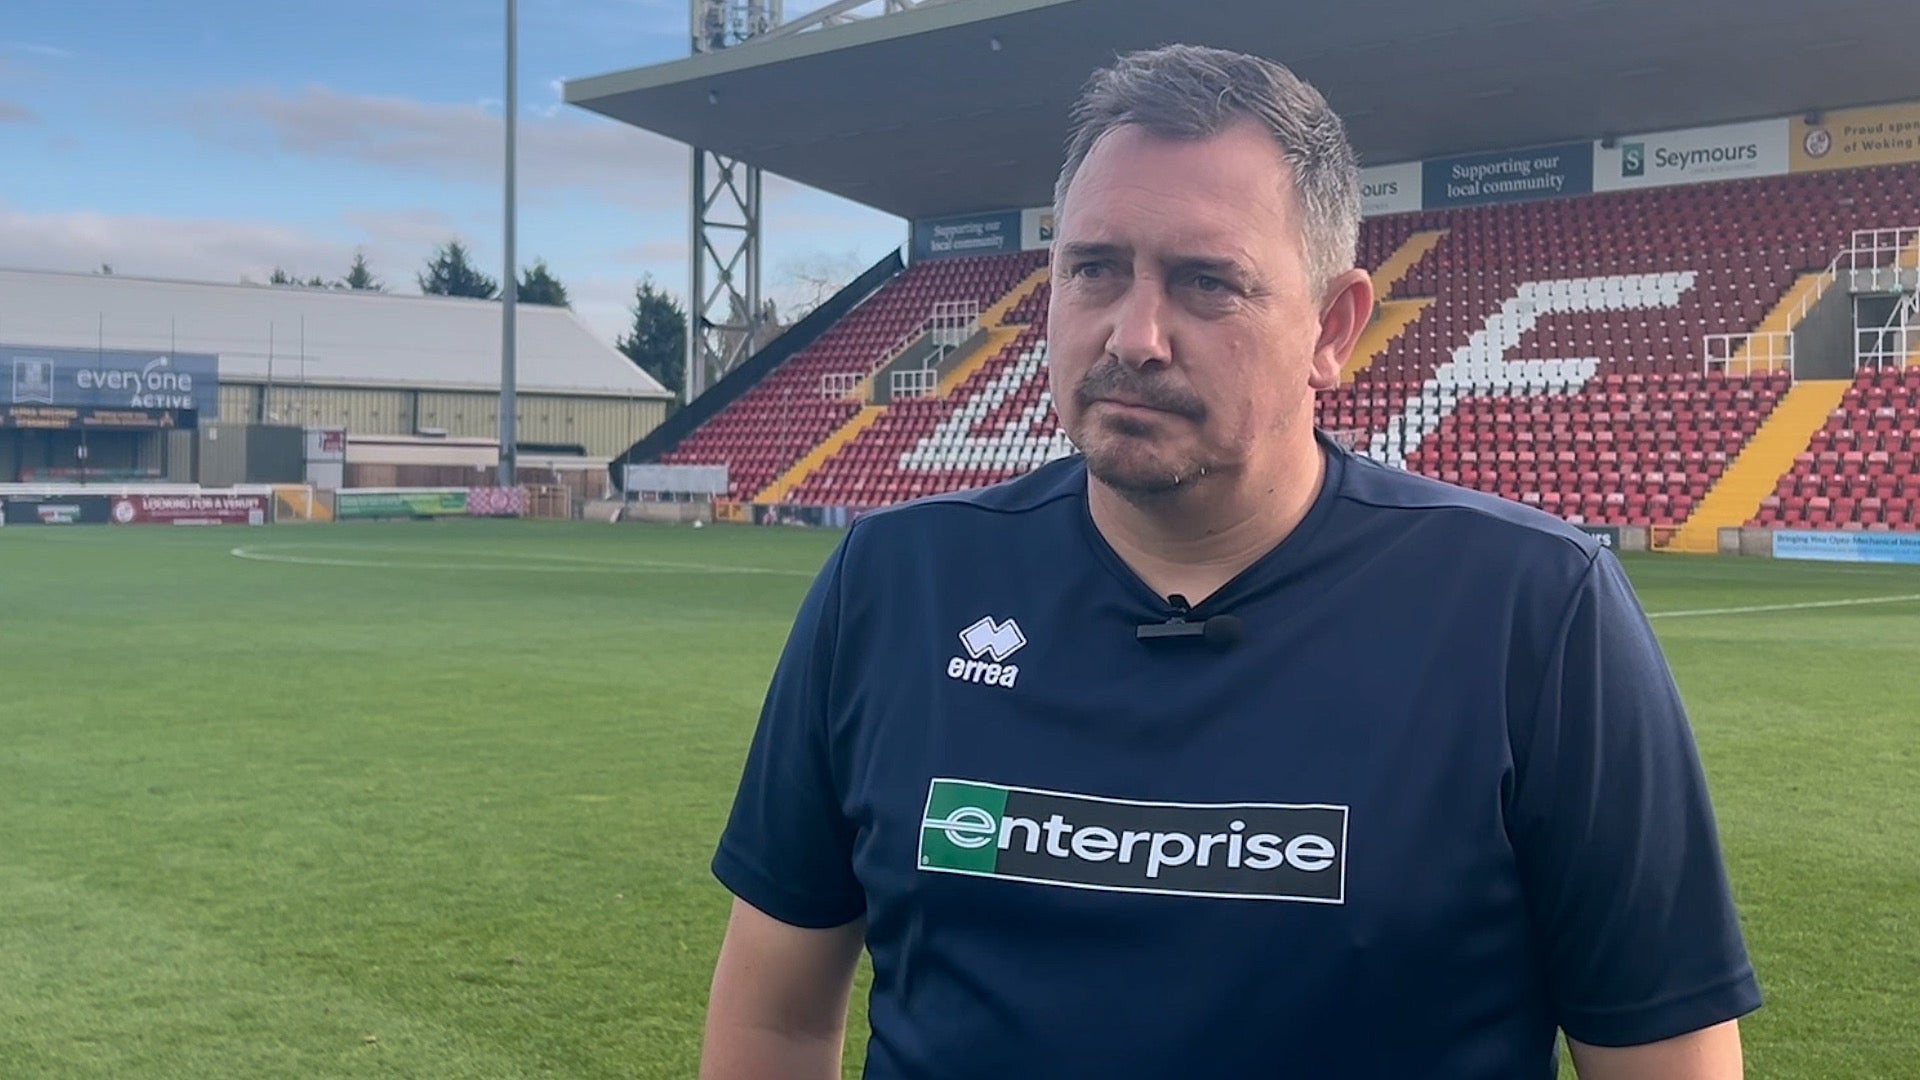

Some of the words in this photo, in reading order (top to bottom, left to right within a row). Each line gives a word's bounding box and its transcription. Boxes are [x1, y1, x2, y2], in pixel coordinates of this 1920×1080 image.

[1844, 122, 1884, 137] Proud
[1654, 143, 1758, 171] Seymours
[1844, 141, 1857, 153] of
[1861, 138, 1912, 151] Woking
[1451, 160, 1531, 182] Supporting
[1534, 155, 1560, 169] our
[1447, 183, 1480, 198] local
[1482, 174, 1565, 194] community
[934, 224, 984, 240] Supporting
[77, 357, 192, 393] everyone
[131, 394, 192, 409] ACTIVE
[947, 656, 1019, 688] errea
[941, 806, 1336, 878] enterprise
